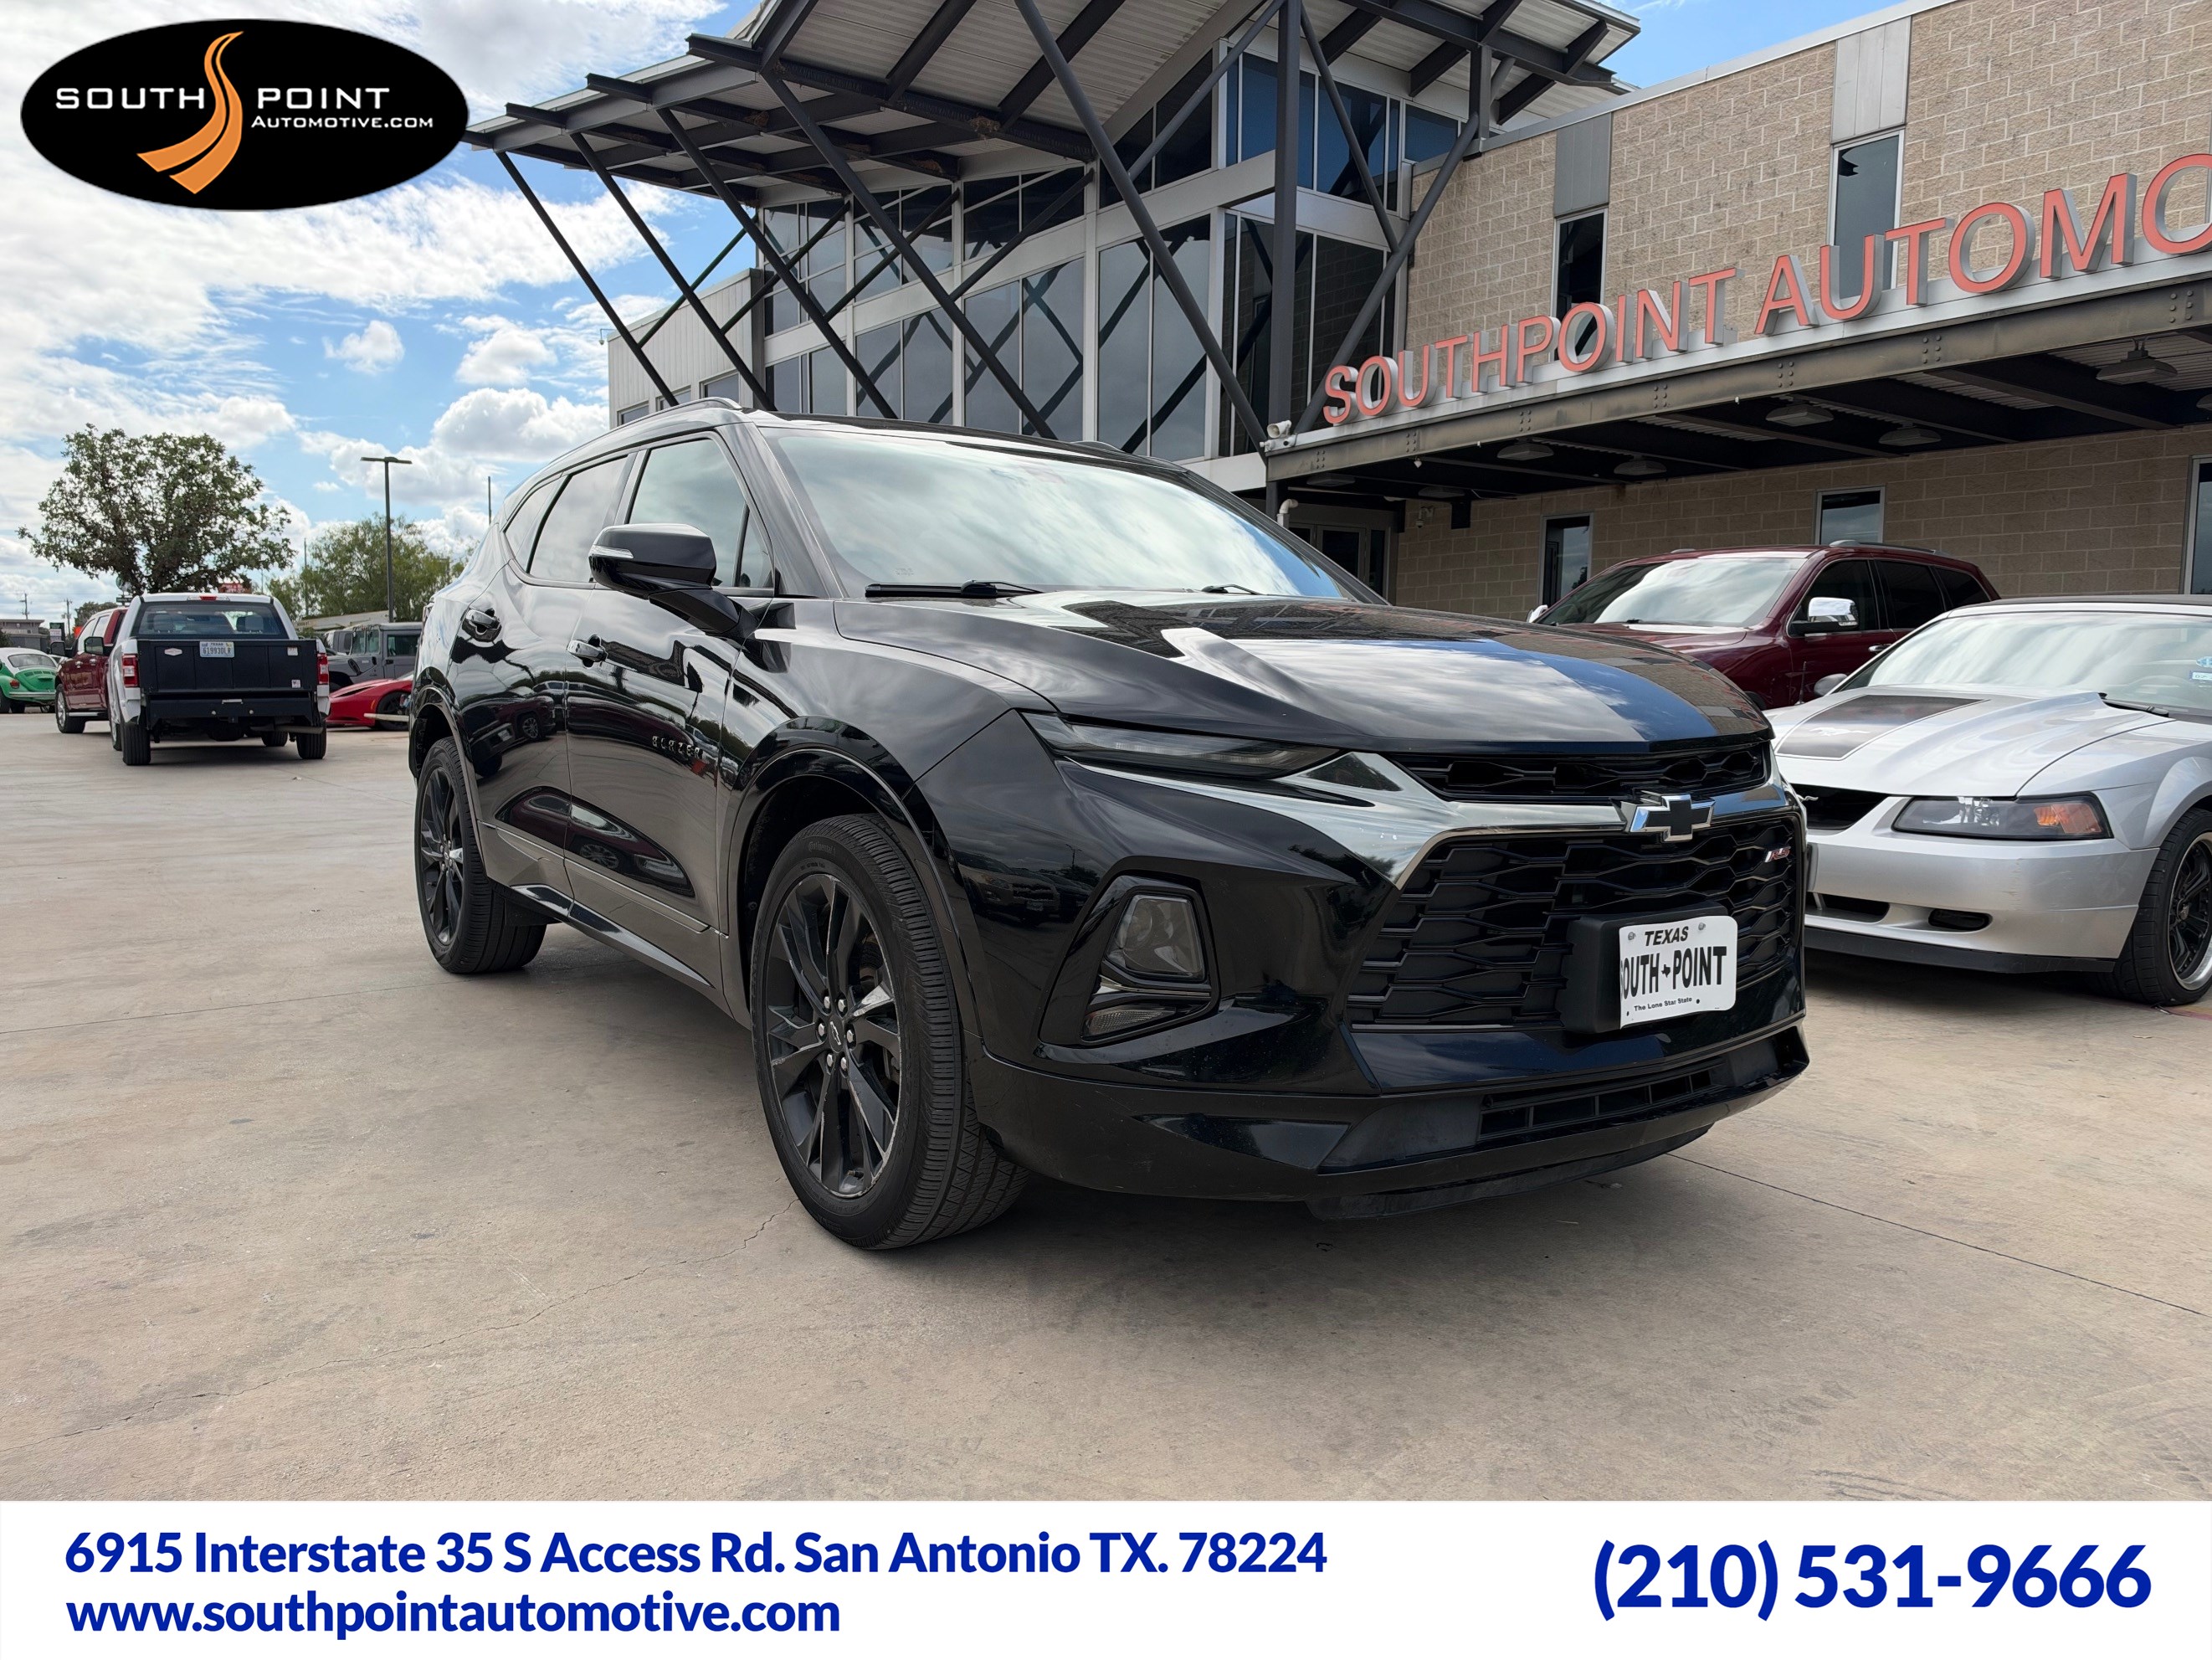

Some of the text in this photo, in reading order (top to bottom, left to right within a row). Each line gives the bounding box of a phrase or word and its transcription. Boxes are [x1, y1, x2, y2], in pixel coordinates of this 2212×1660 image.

[1323, 267, 1742, 425] SOUTHPOINT
[1764, 845, 1791, 862] RS
[1644, 926, 1690, 947] TEXAS
[1672, 946, 1727, 990] POINT
